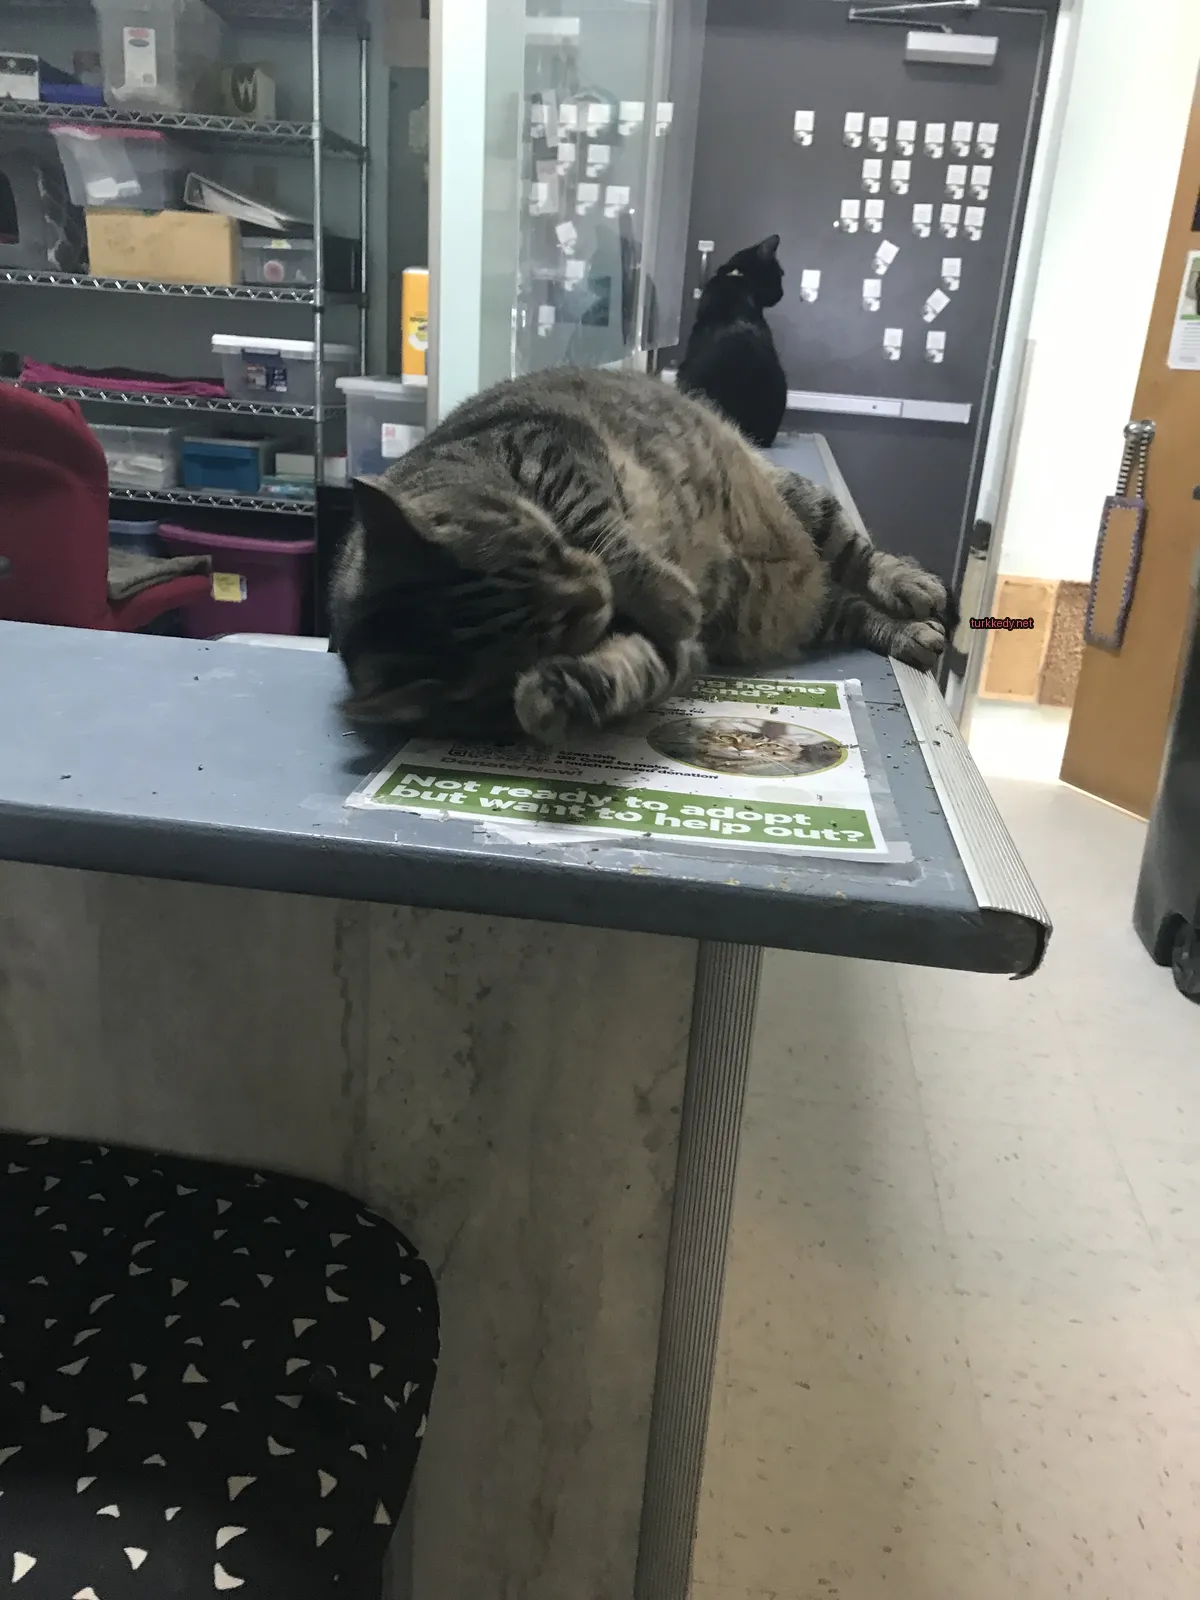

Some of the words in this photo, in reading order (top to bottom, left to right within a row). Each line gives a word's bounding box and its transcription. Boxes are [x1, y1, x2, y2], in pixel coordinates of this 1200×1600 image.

[736, 681, 826, 694] home
[580, 756, 614, 764] Code
[605, 765, 655, 773] needed
[401, 773, 480, 792] Not
[490, 787, 612, 807] ready
[625, 796, 669, 811] to
[680, 804, 811, 825] adopt
[389, 784, 468, 804] but
[479, 797, 586, 817] want
[595, 807, 642, 822] to
[655, 813, 751, 834] help
[764, 826, 865, 842] out?
